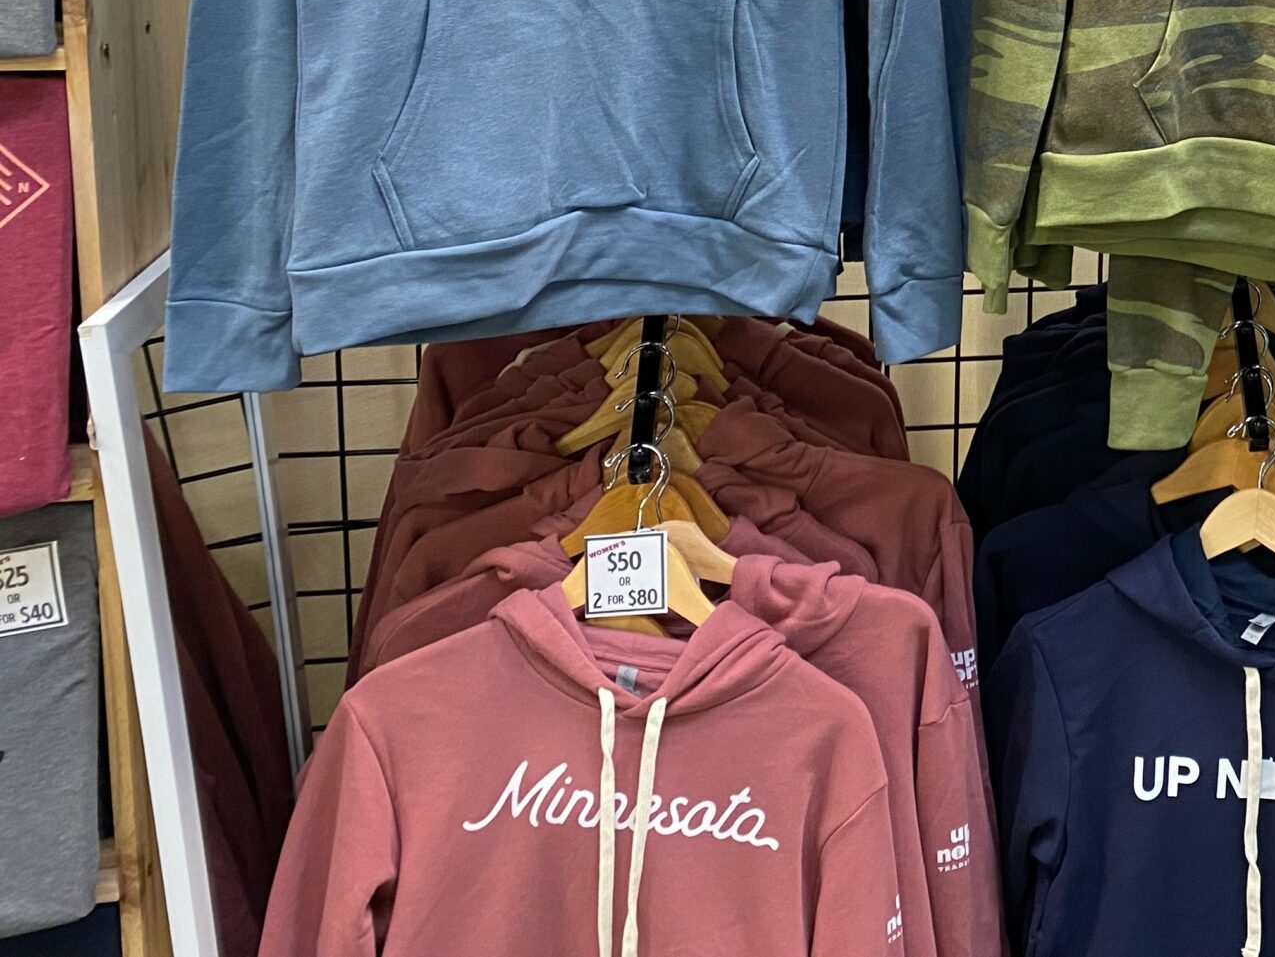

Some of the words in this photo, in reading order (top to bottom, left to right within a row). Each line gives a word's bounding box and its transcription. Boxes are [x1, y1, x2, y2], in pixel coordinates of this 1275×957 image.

[18, 182, 30, 193] N
[589, 540, 626, 559] WOMEN'S
[607, 550, 642, 573] $50
[618, 576, 631, 587] OR
[7, 593, 20, 604] OR
[593, 592, 602, 609] 2
[607, 595, 624, 605] FOR
[628, 588, 658, 607] $80
[20, 602, 53, 623] $40
[950, 648, 975, 667] up
[1133, 755, 1200, 802] UP
[462, 760, 780, 851] Minnesota
